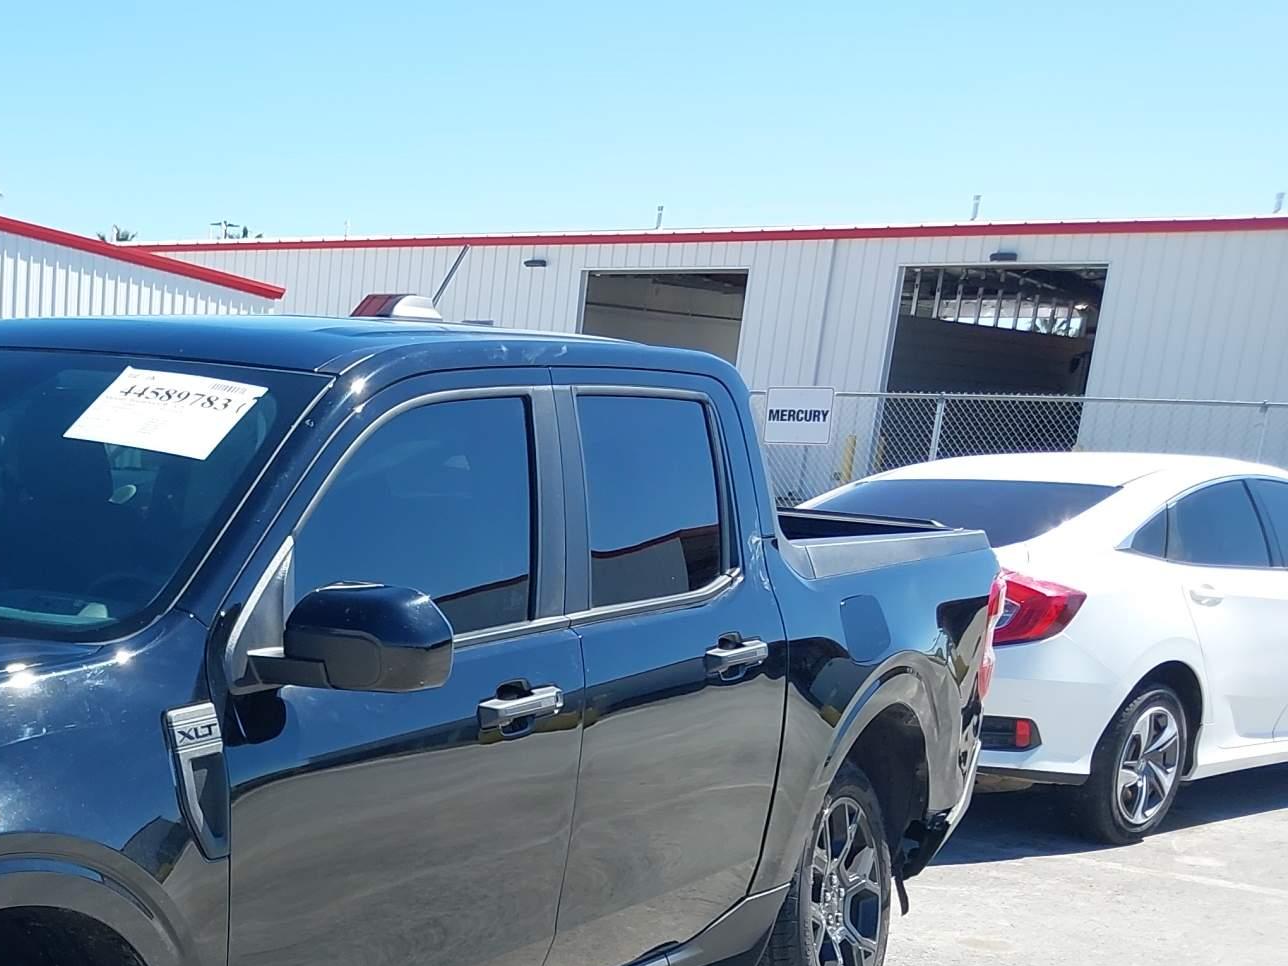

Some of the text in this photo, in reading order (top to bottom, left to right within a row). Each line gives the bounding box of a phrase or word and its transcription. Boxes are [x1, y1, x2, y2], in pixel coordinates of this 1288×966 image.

[120, 384, 232, 411] 44589783
[768, 409, 829, 422] MERCURY
[177, 723, 217, 743] XLT
